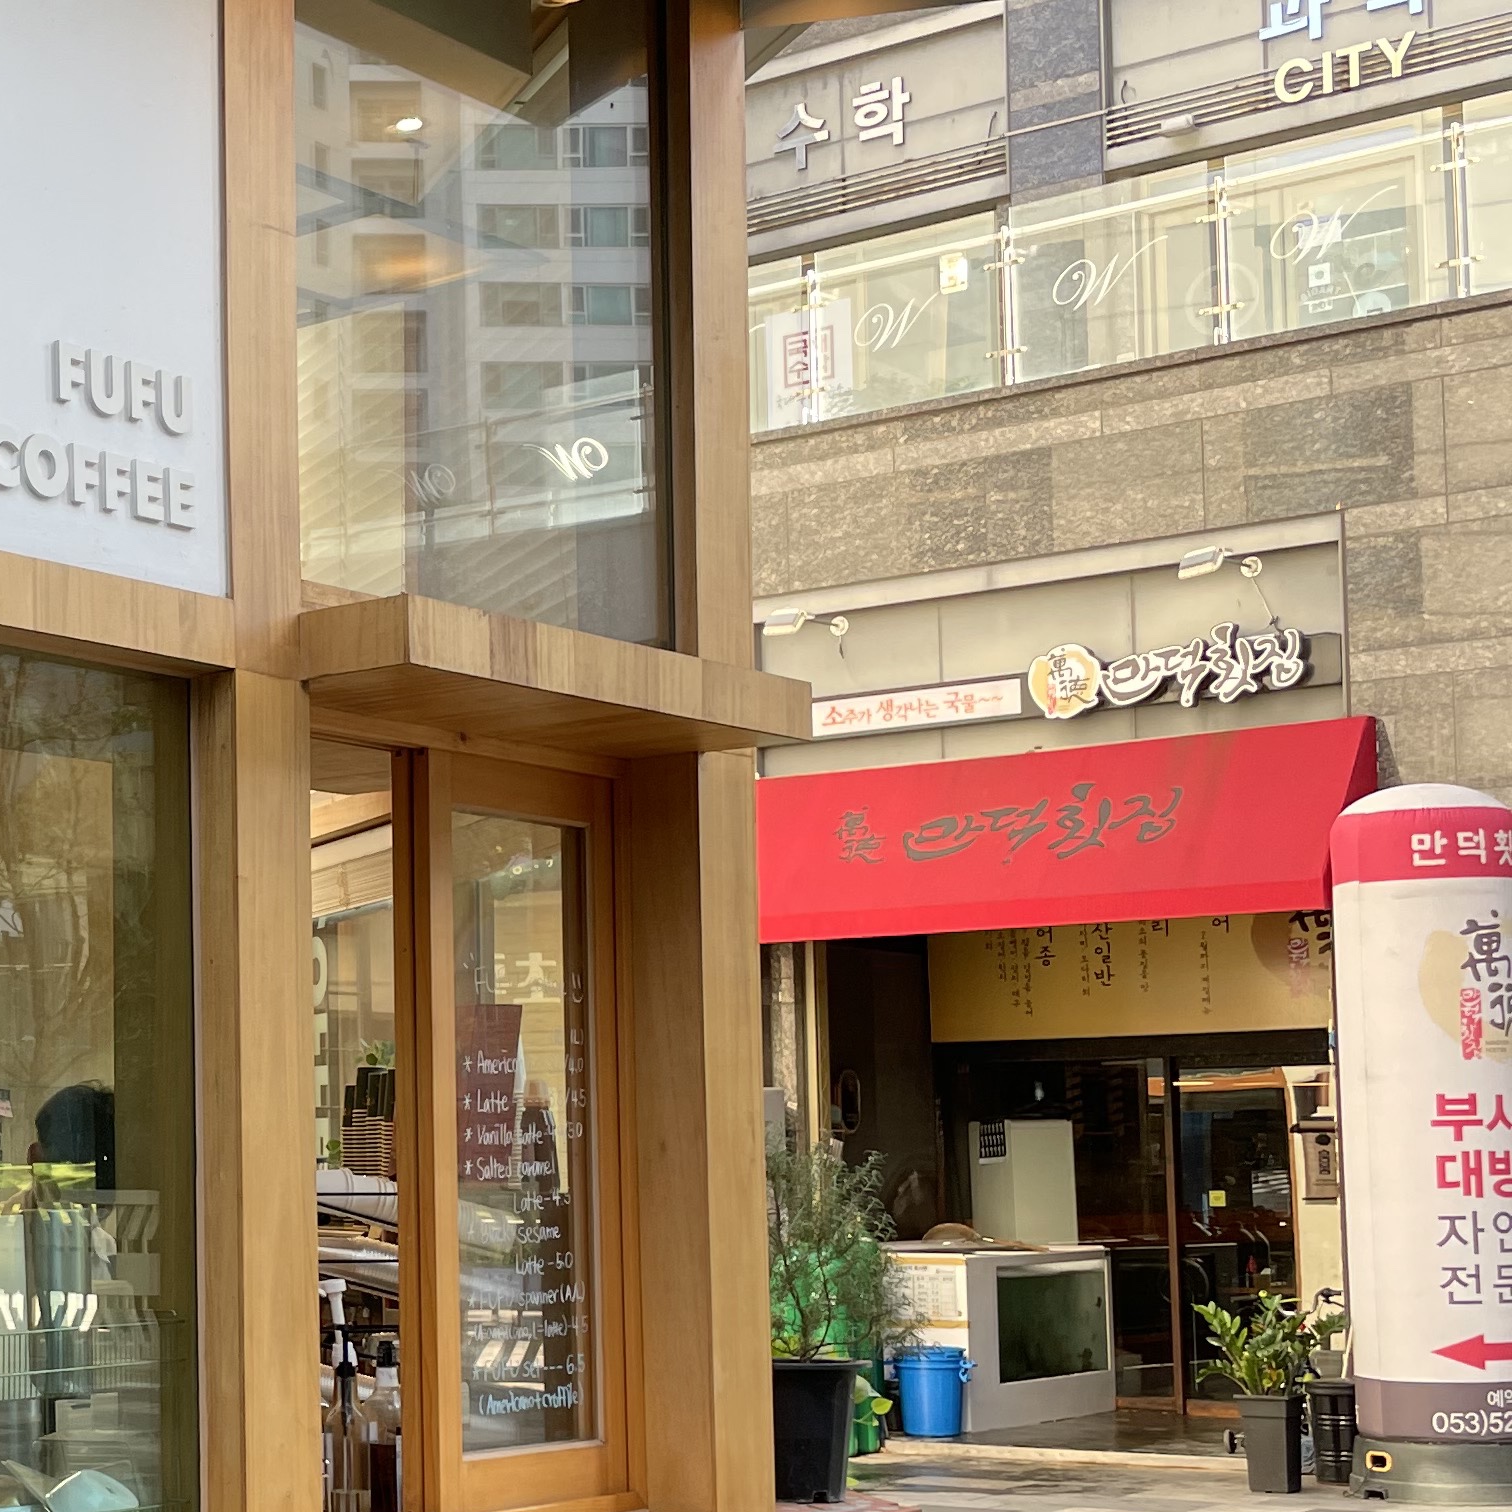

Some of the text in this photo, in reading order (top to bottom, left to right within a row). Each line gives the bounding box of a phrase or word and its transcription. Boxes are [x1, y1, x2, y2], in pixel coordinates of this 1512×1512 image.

[1274, 31, 1416, 103] CITY
[774, 77, 910, 170] 수학
[50, 340, 193, 437] FUFU
[821, 705, 872, 728] 소주가
[877, 697, 939, 723] 생각나는
[477, 1089, 509, 1114] Latte
[517, 1225, 561, 1244] sesame
